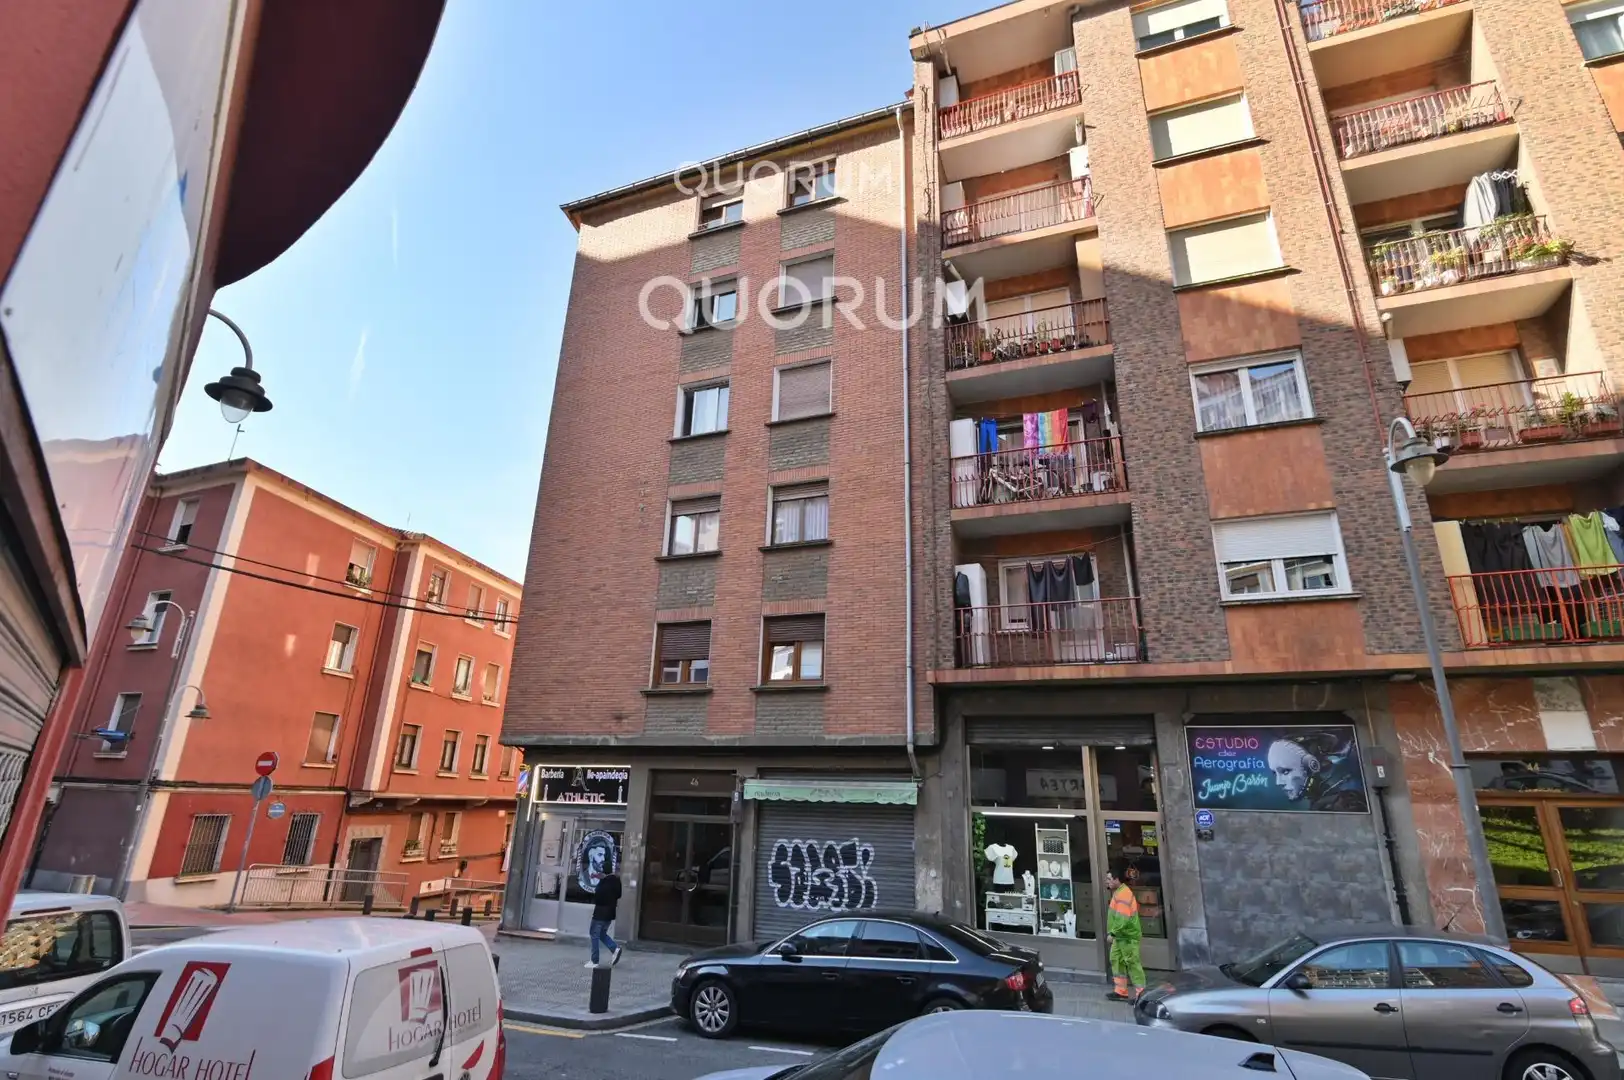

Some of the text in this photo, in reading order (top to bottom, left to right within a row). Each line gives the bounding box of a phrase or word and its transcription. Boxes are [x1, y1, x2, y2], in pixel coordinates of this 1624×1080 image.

[1195, 737, 1259, 749] ESTUDIO
[556, 791, 606, 803] ATHLETIC
[1, 1009, 34, 1025] 1564
[389, 1020, 442, 1052] HOGAR
[128, 1036, 190, 1080] HOGAR
